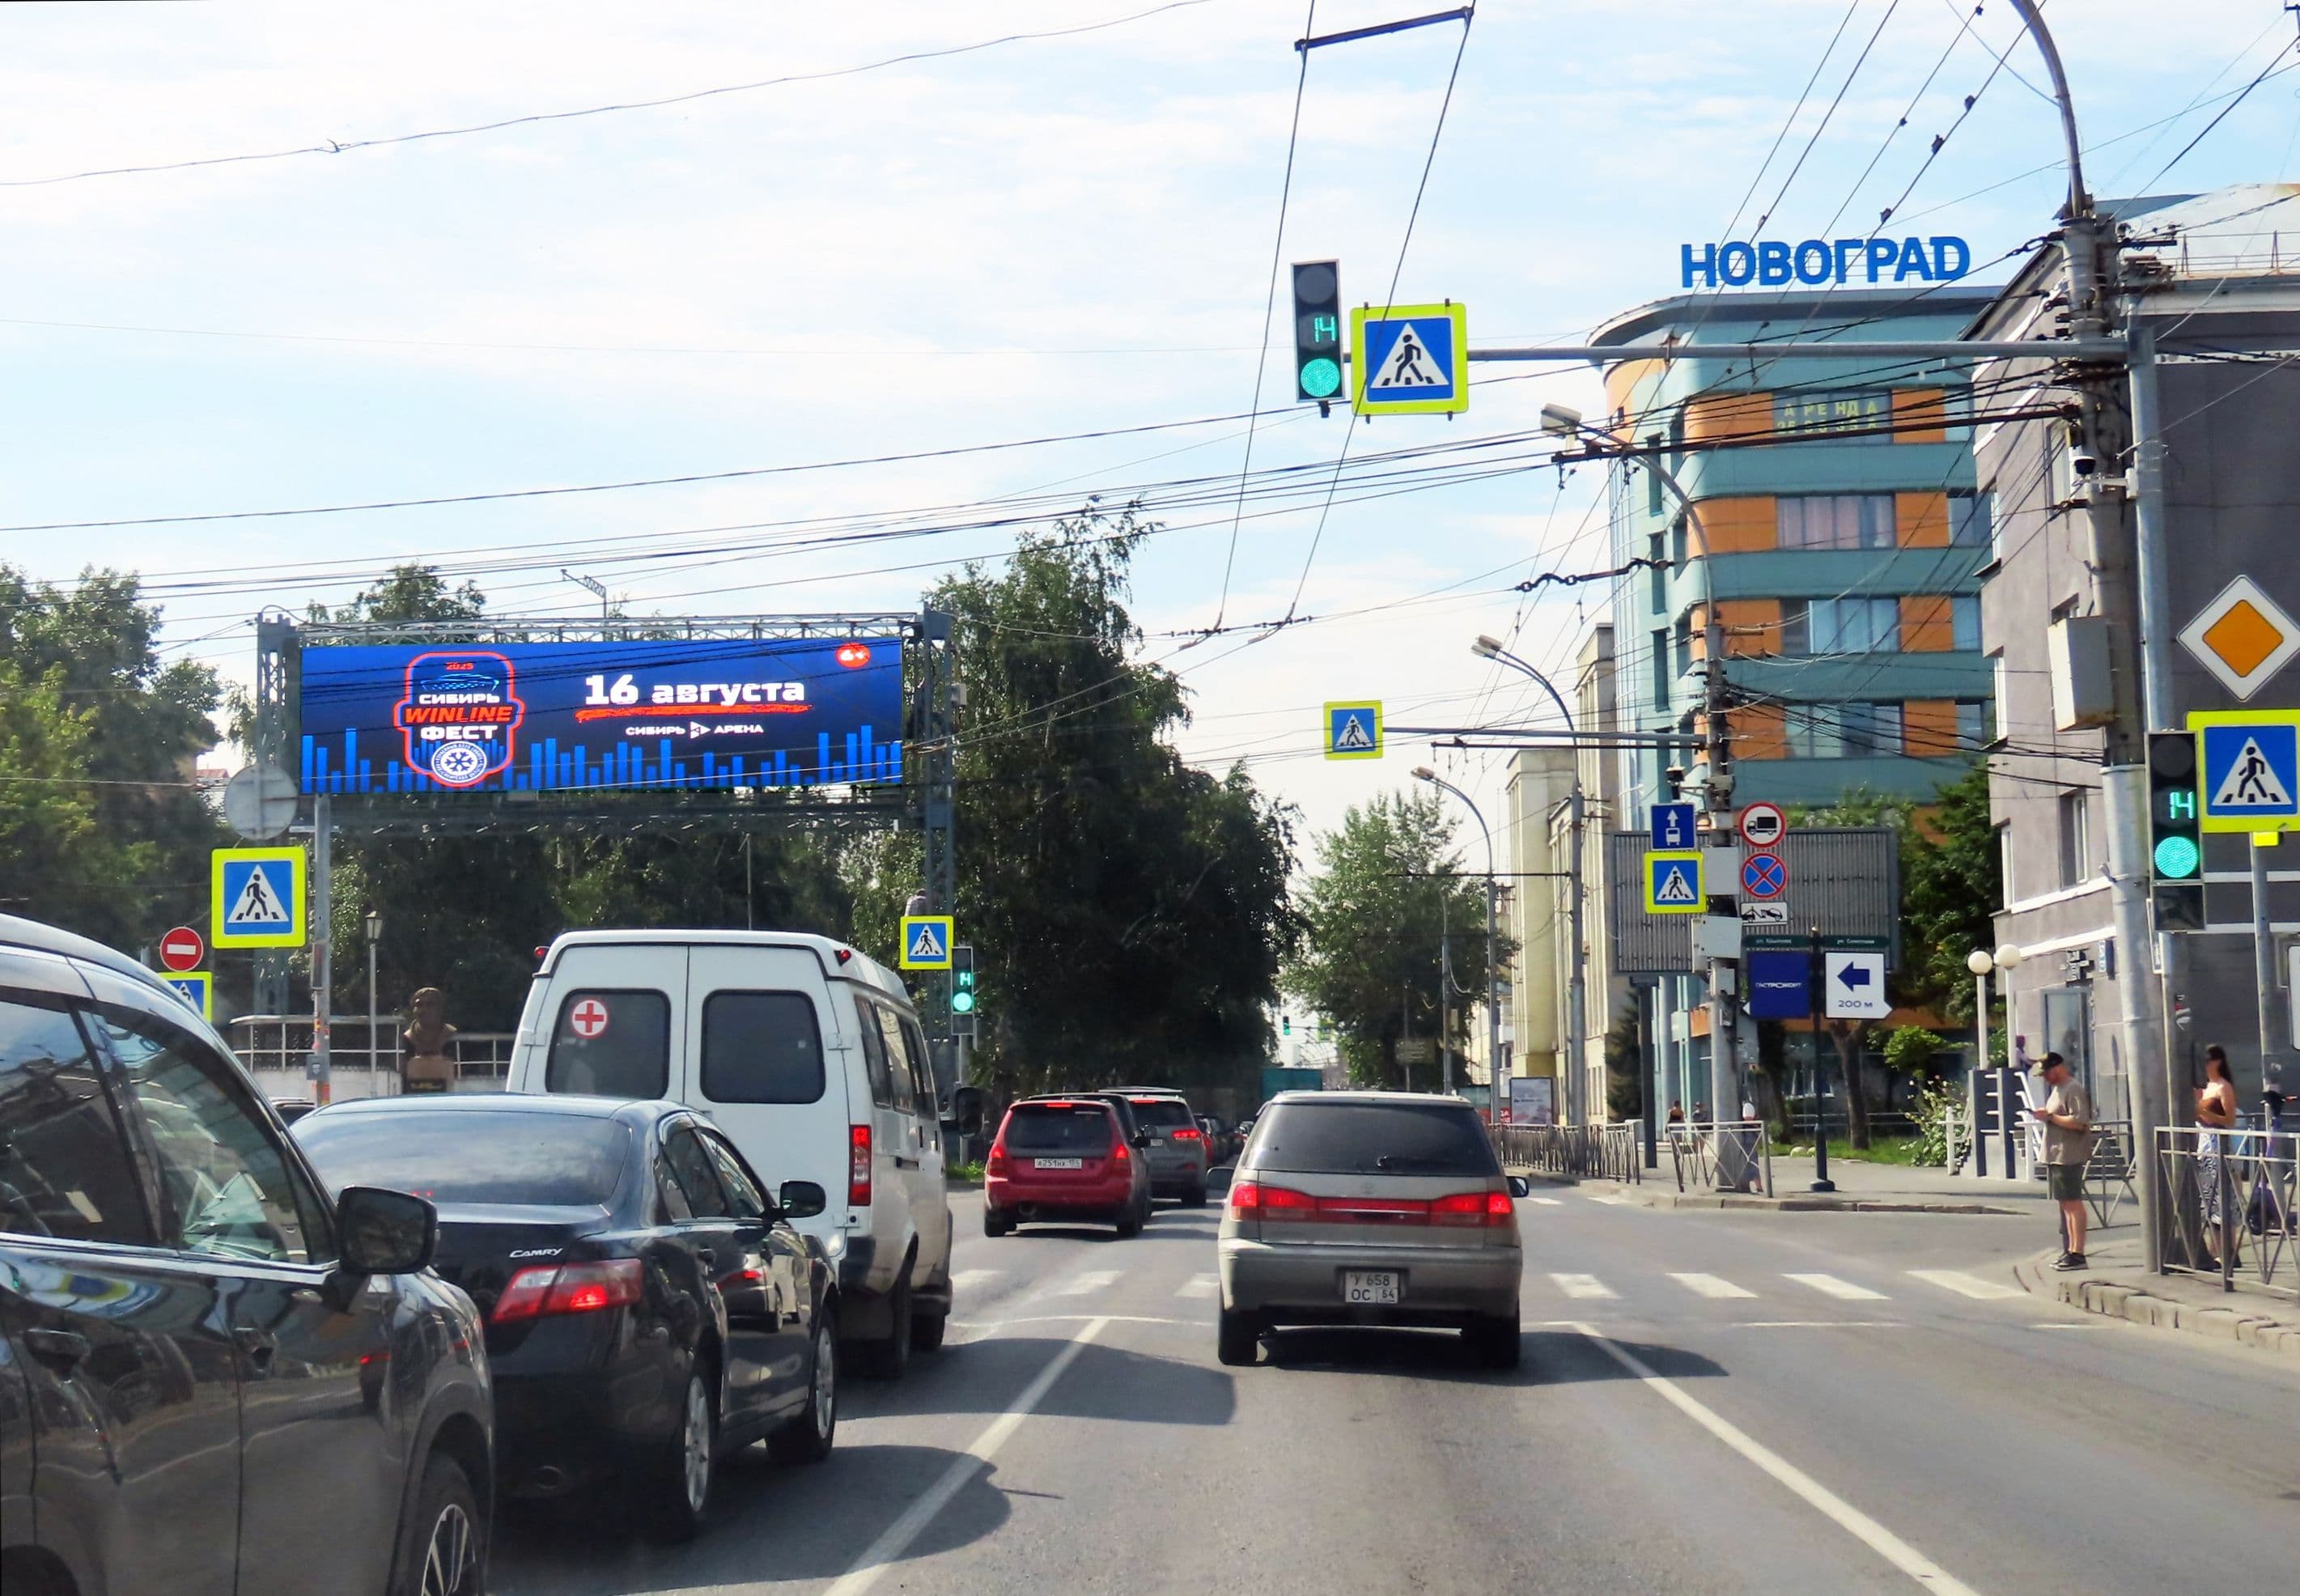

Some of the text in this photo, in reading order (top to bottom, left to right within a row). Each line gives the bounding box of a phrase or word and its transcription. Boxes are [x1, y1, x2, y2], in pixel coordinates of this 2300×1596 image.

[1681, 236, 1971, 288] НОВОГРАД
[1314, 316, 1336, 342] 14
[1784, 400, 1878, 418] АРЕНДА
[840, 649, 864, 661] 6+
[446, 661, 475, 671] 2025
[584, 674, 804, 707] 16 августа
[418, 694, 500, 705] СИБИРЬ
[405, 706, 513, 724] WINLINE
[420, 725, 499, 741] ФЕСТ
[626, 724, 763, 736] СИБИРЬ АРЕНА
[2170, 791, 2195, 820] 14
[1838, 1000, 1862, 1008] 200
[509, 1247, 564, 1259] CAMRY
[1366, 1274, 1390, 1287] 658
[1352, 1288, 1371, 1301] ОС
